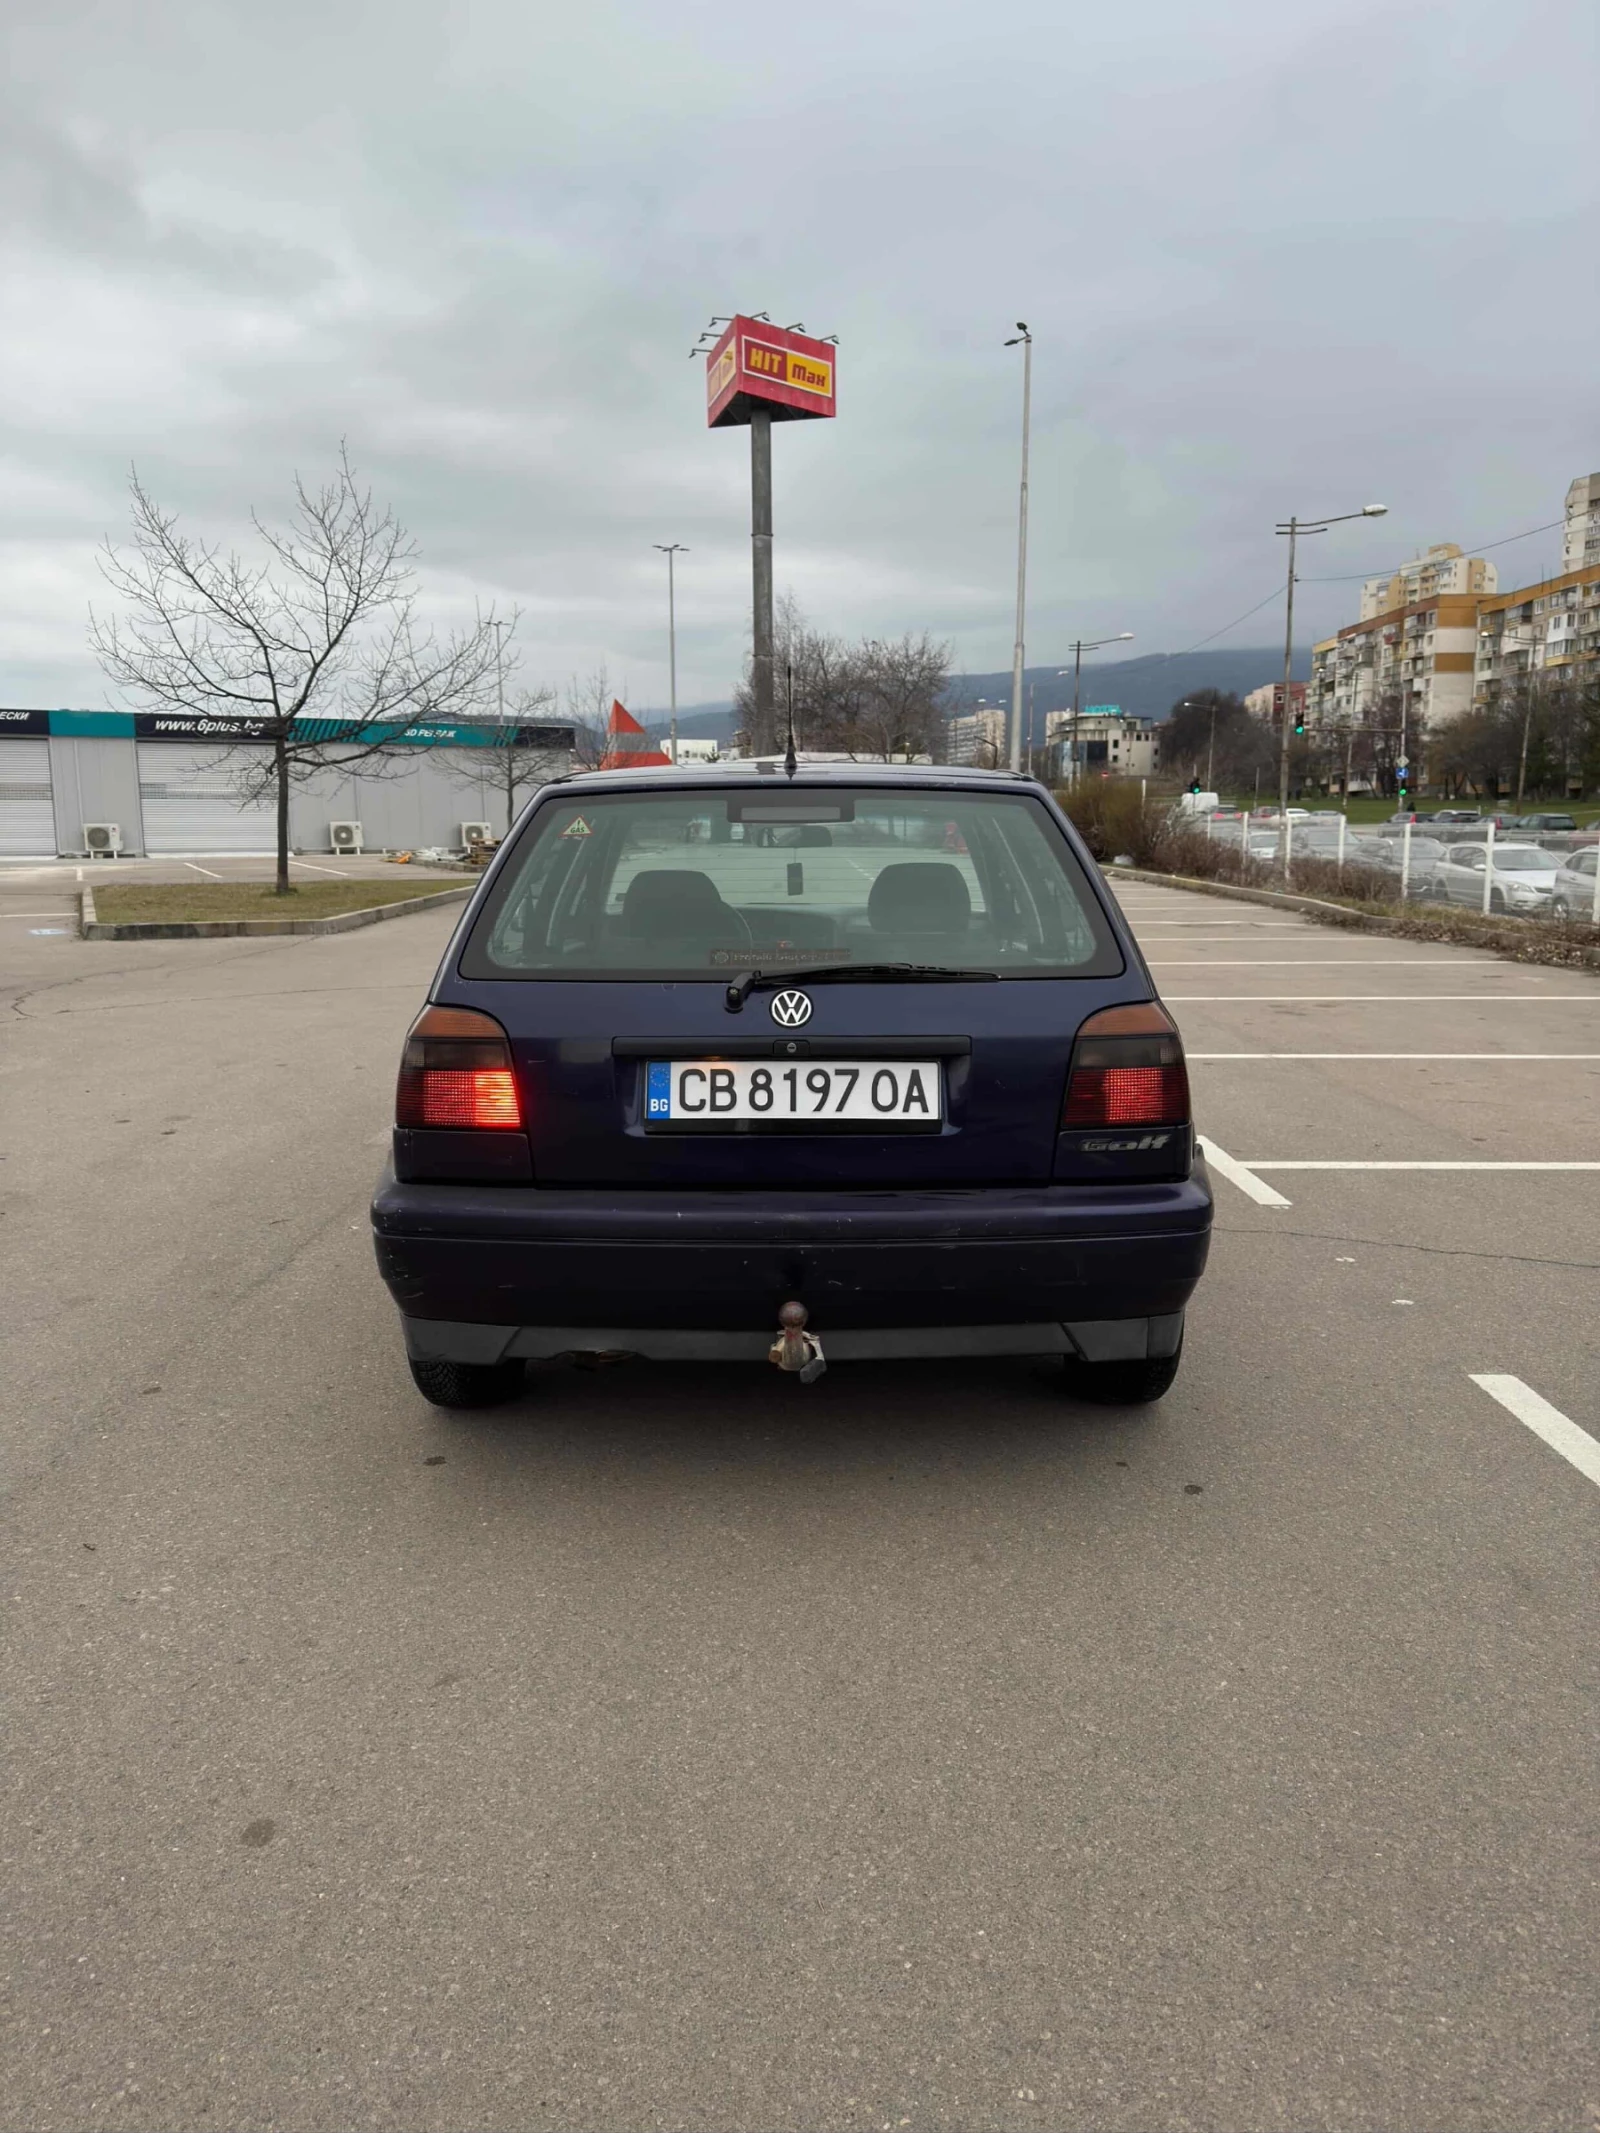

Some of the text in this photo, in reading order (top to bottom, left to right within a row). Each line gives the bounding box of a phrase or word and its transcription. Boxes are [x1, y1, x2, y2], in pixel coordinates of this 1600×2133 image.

[749, 347, 782, 374] HIT
[155, 718, 265, 736] www.6plus.bg
[570, 826, 585, 834] GAS
[679, 1068, 737, 1112] CB
[748, 1068, 860, 1112] 8197
[650, 1098, 669, 1112] BG
